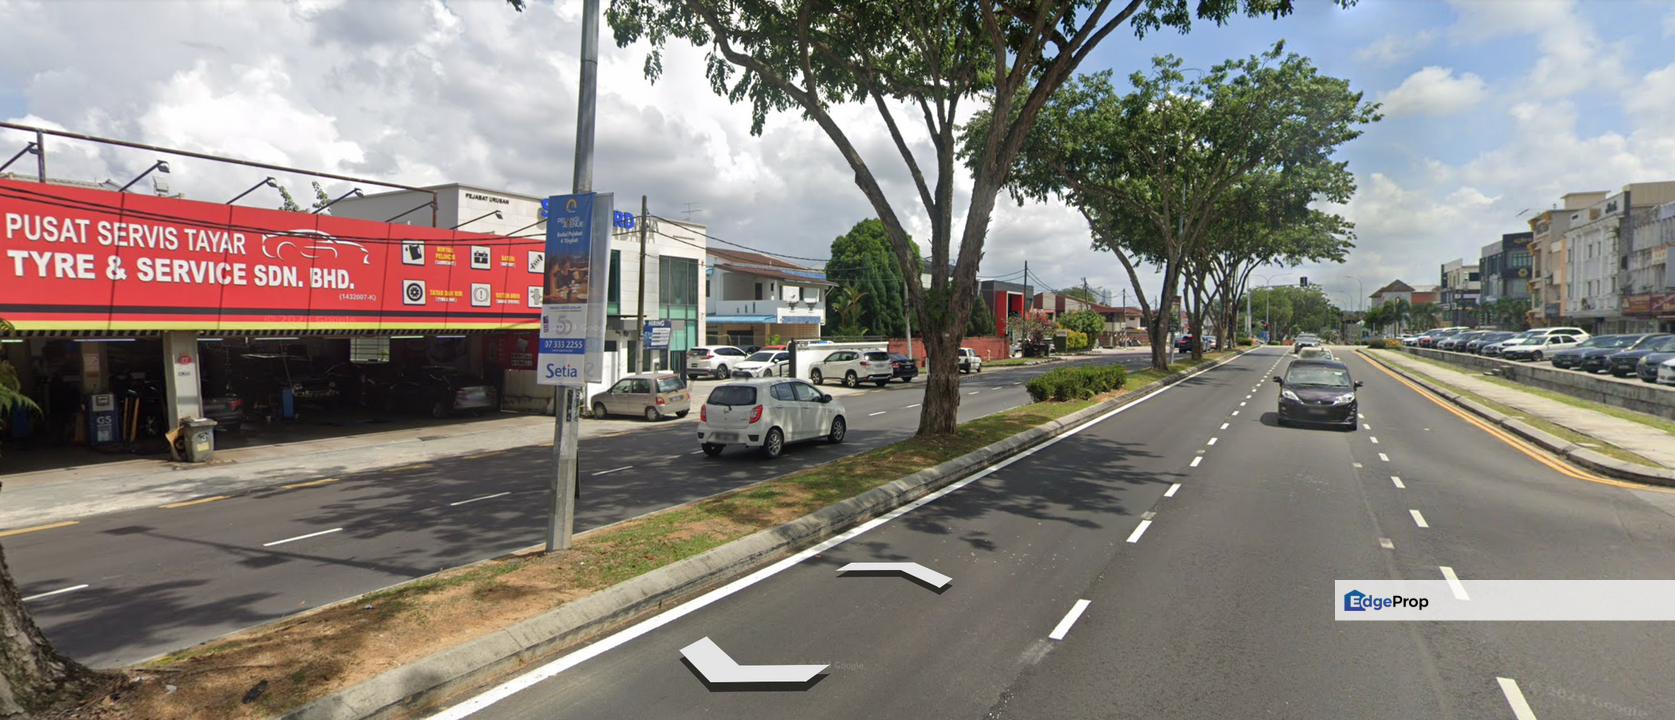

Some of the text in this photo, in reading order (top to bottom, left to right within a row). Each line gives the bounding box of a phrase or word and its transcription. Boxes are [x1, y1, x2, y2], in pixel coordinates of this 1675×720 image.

[465, 193, 509, 205] PEJABAT URUSAN
[6, 213, 246, 255] PUSAT SERVIS TAYAR
[7, 250, 355, 290] TYRE & SERVICE SDN. BHD.
[339, 293, 376, 301] (1432007-K)
[545, 340, 583, 349] 07 333 2255
[545, 363, 577, 378] Setia
